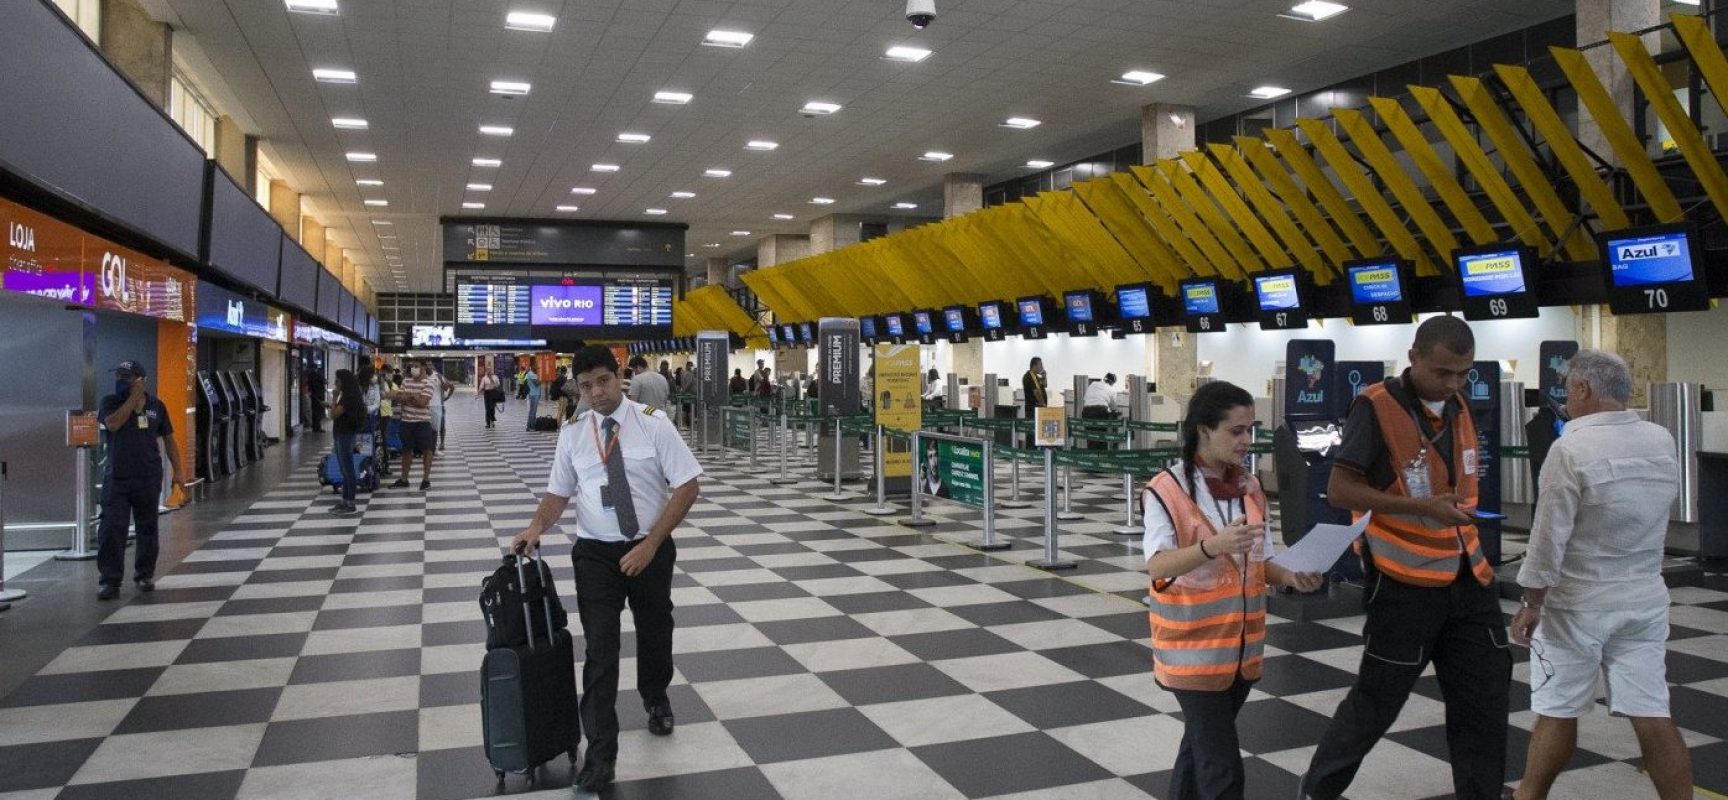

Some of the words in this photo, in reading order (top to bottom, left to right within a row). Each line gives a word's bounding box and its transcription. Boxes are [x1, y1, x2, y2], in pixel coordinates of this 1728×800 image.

[10, 221, 35, 252] LOJA
[1622, 245, 1658, 259] Azul
[102, 251, 129, 304] GOL
[1357, 271, 1390, 283] PASS
[540, 295, 571, 308] vivo
[573, 299, 593, 308] RIO
[1644, 288, 1668, 309] 70
[1373, 305, 1389, 322] 68
[1489, 298, 1508, 317] 69
[1275, 312, 1288, 327] 67
[833, 335, 842, 384] PREMIUM
[1297, 390, 1324, 402] Azul
